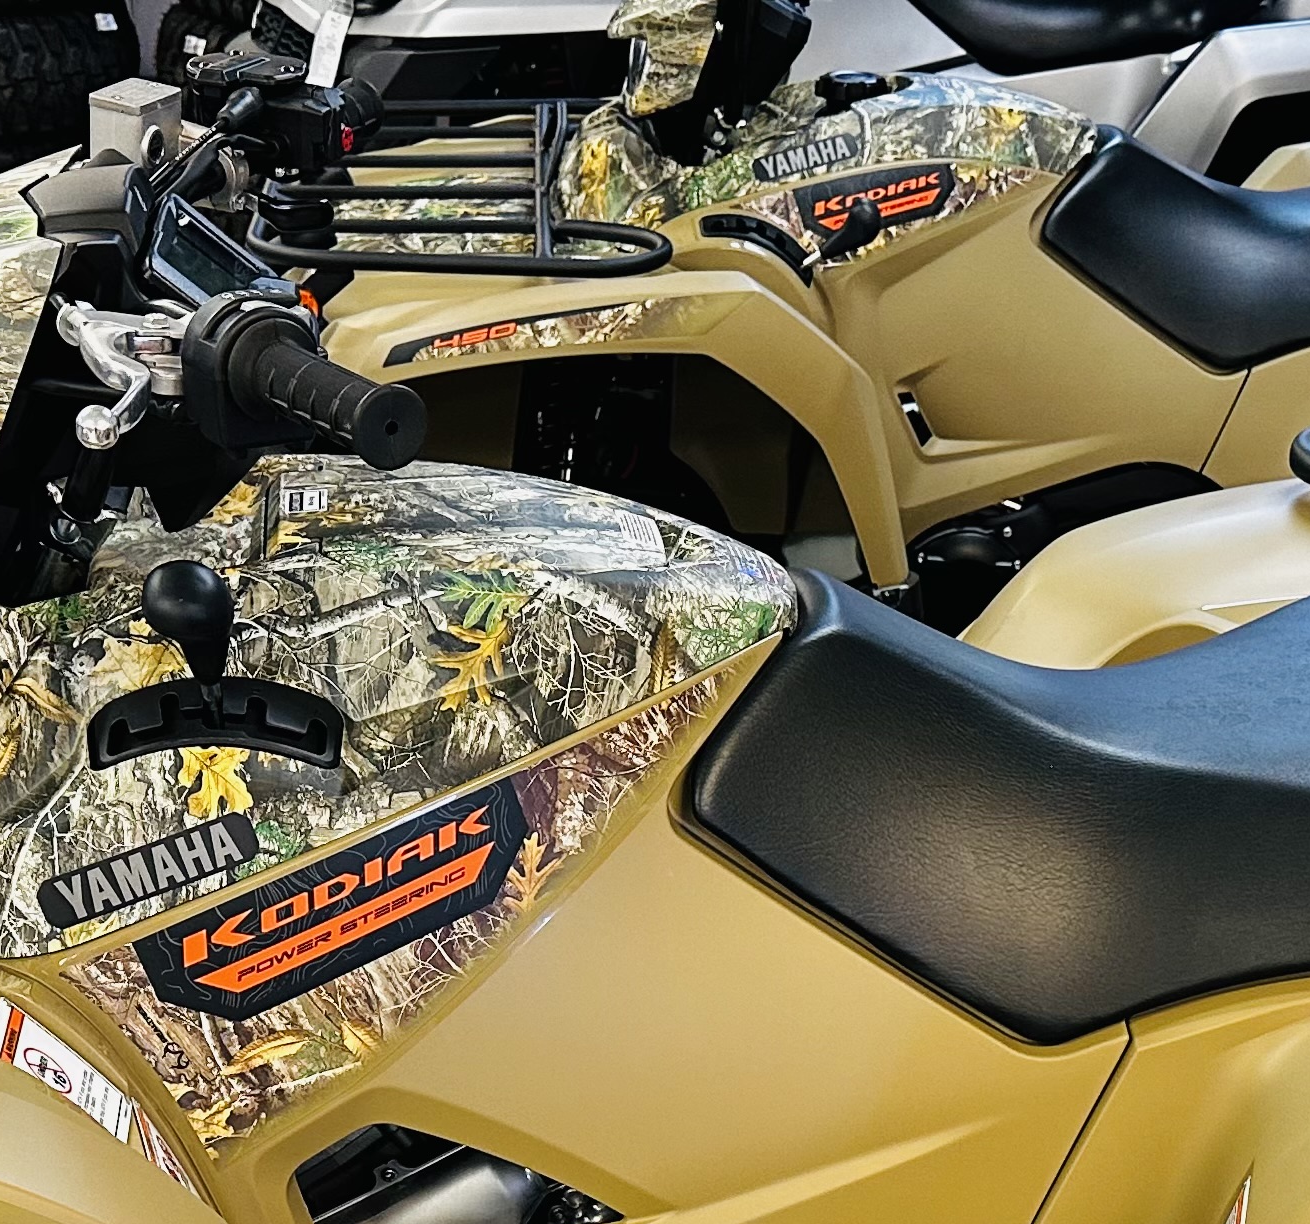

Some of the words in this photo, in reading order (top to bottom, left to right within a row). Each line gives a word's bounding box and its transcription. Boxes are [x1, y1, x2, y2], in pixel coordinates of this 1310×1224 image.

[759, 136, 851, 179] YAMAHA
[433, 321, 518, 349] 450
[52, 820, 243, 920] YAMAHA
[183, 805, 491, 968] KODIAK
[236, 928, 334, 983] POWER
[340, 864, 466, 936] STEERING
